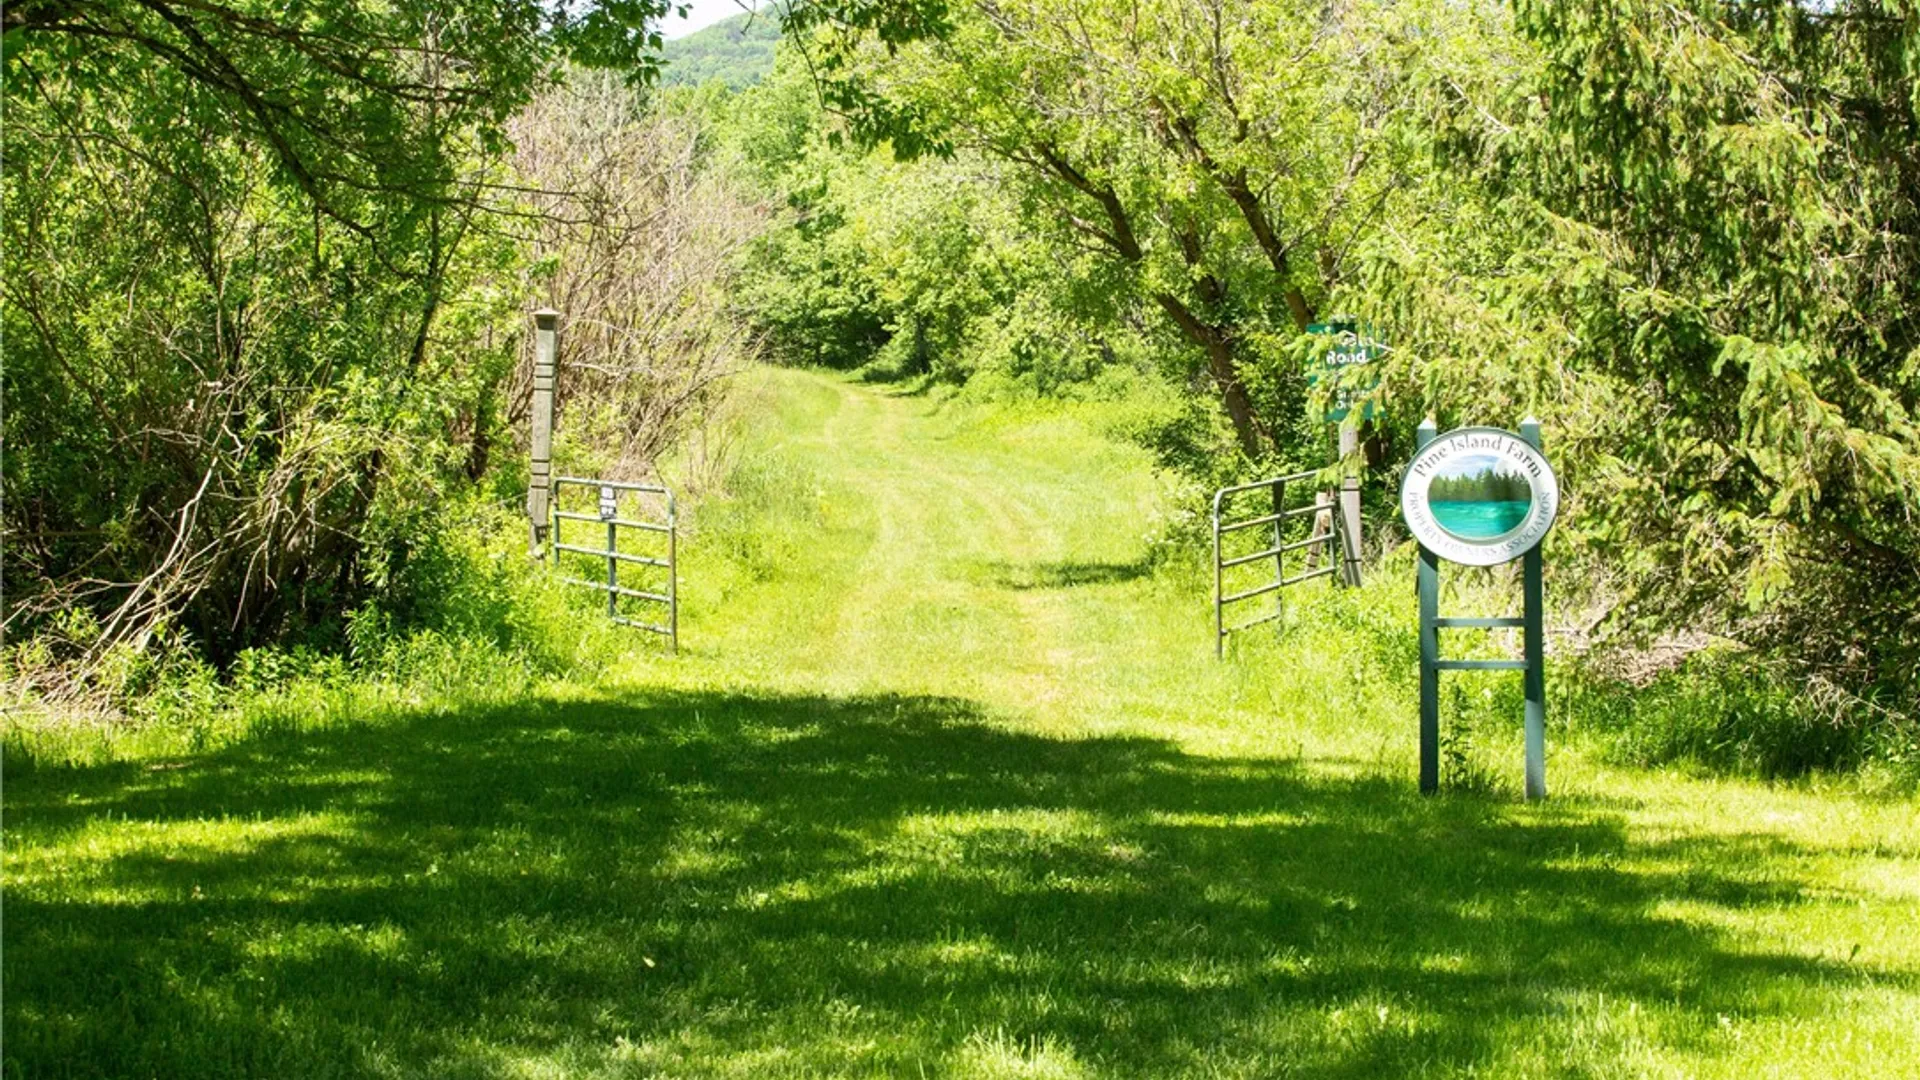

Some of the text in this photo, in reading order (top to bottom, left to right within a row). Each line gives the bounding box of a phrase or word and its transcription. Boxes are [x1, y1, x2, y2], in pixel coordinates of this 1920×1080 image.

[1326, 349, 1367, 365] Road
[1413, 434, 1542, 478] Pine Island Farm
[1409, 492, 1441, 545] PROPERTY
[1501, 492, 1550, 552] ASSOCIATION
